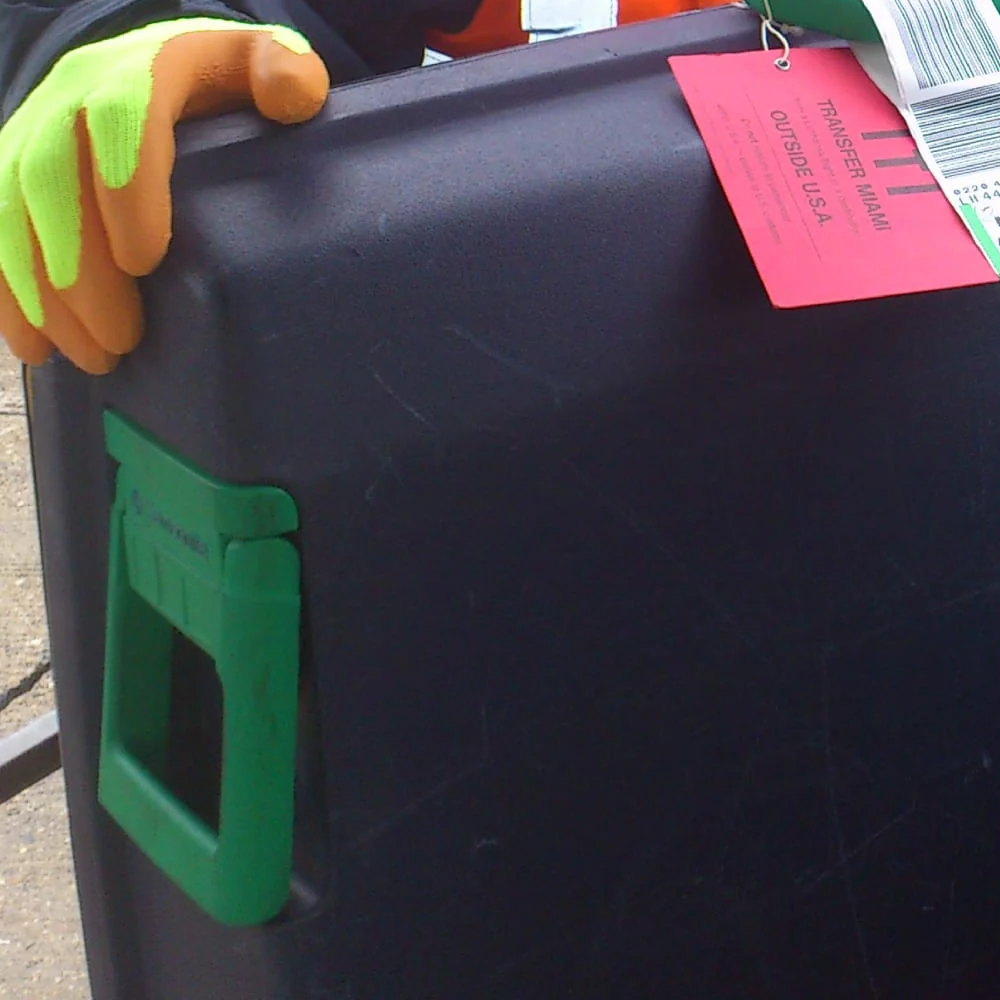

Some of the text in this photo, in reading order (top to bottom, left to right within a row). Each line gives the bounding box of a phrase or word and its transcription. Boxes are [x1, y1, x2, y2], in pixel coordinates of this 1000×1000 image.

[770, 109, 814, 179] OUTSIDE
[802, 181, 833, 227] U.S.A.
[817, 98, 866, 179] TRANSFER
[856, 183, 891, 232] MIAMI
